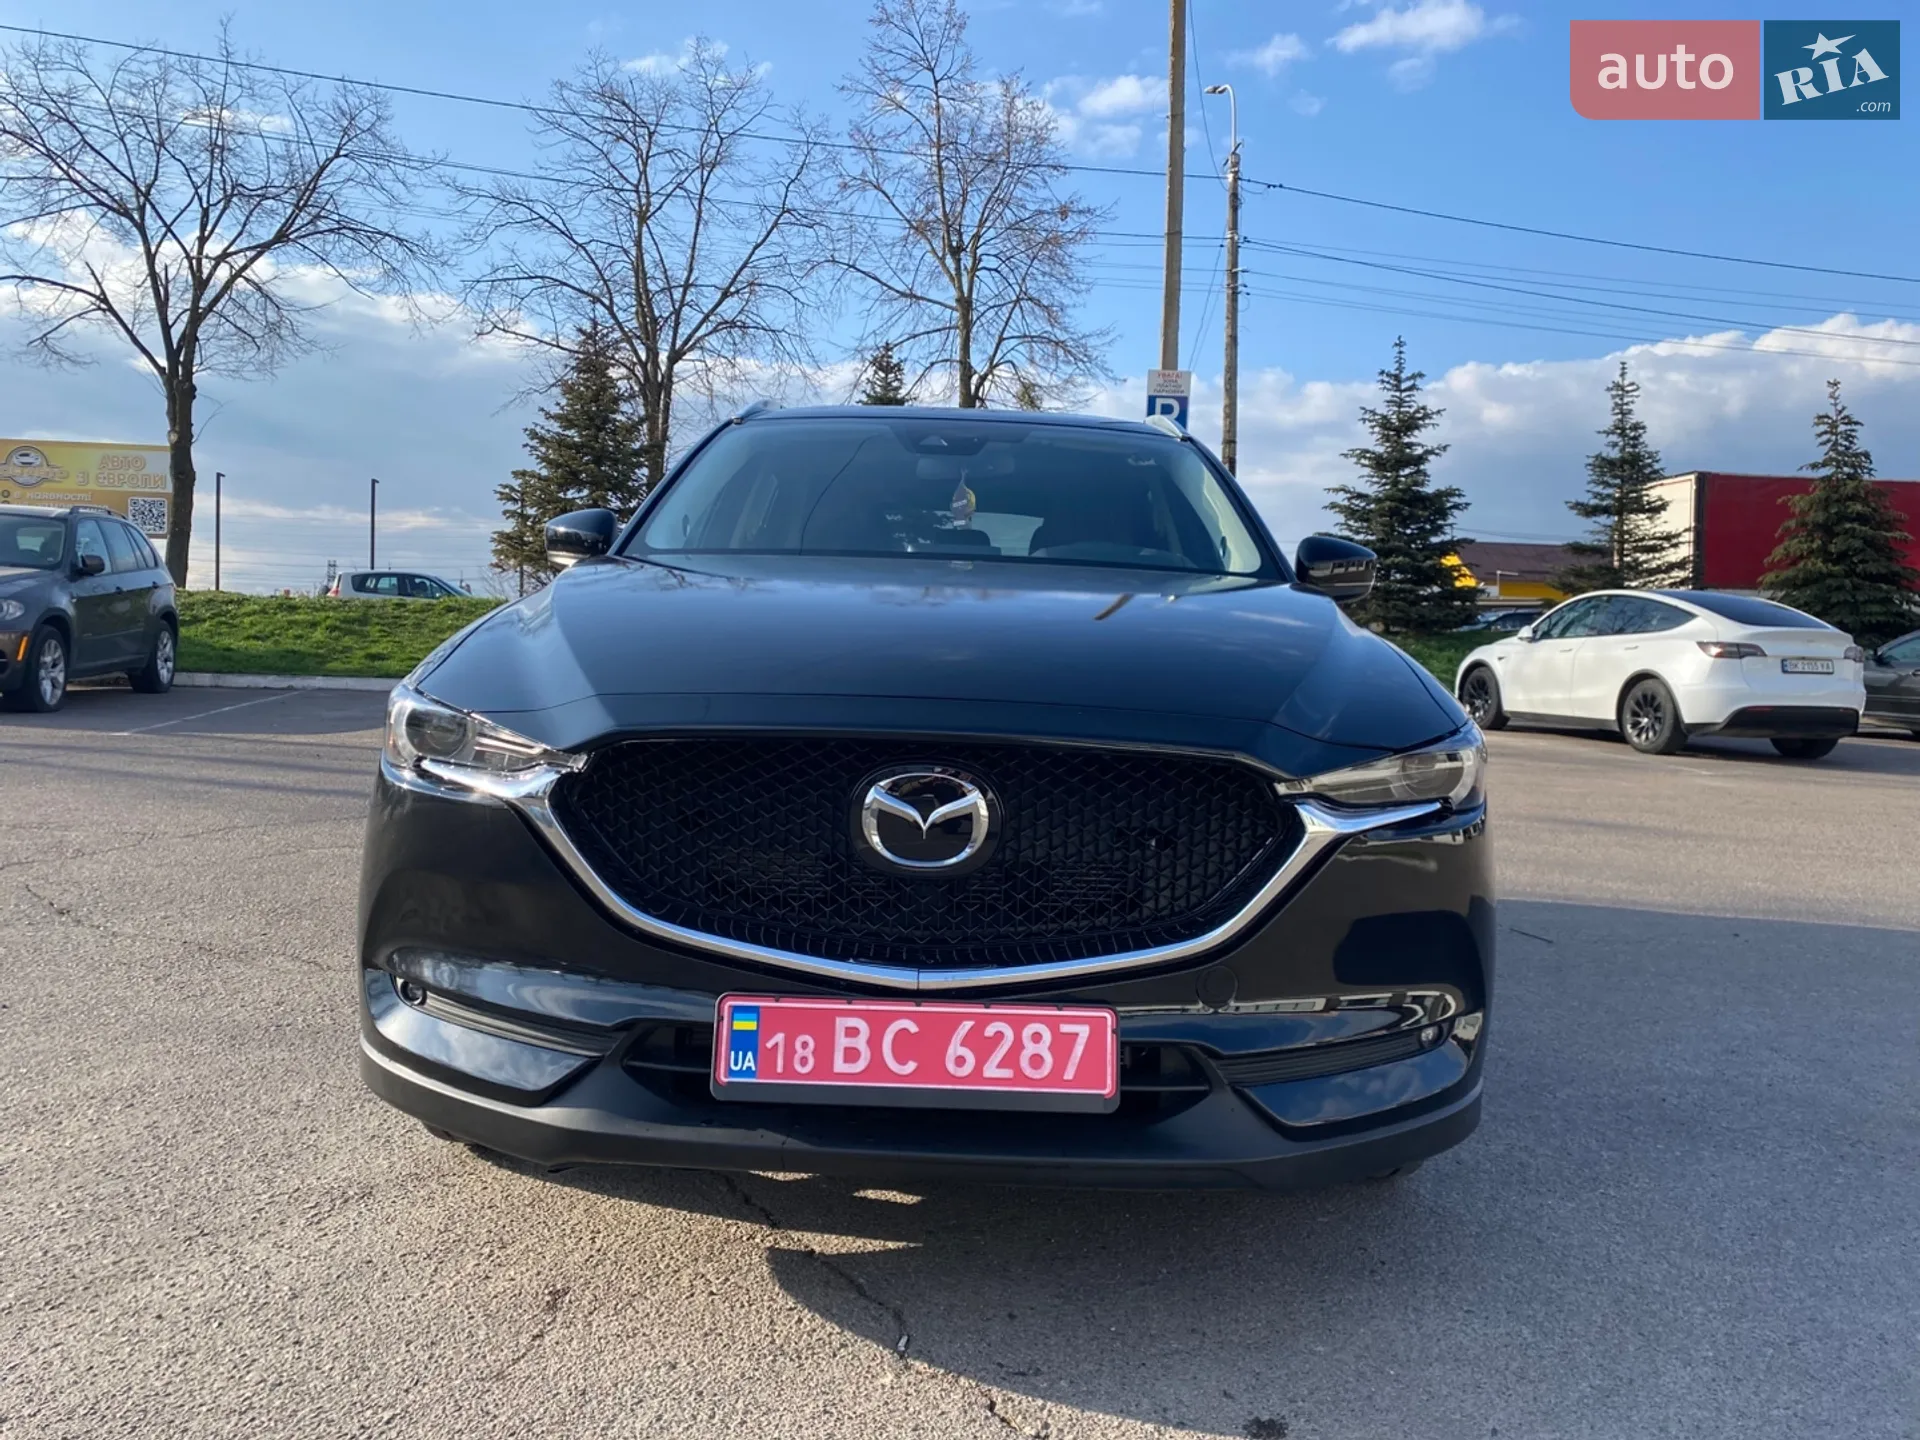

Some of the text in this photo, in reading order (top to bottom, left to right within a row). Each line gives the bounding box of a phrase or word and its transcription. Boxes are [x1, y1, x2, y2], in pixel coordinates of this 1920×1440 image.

[1155, 397, 1180, 421] P
[98, 454, 146, 471] АВТО
[95, 472, 166, 489] ЄВРОПИ
[729, 1016, 1090, 1081] UA 18 BC 6287
